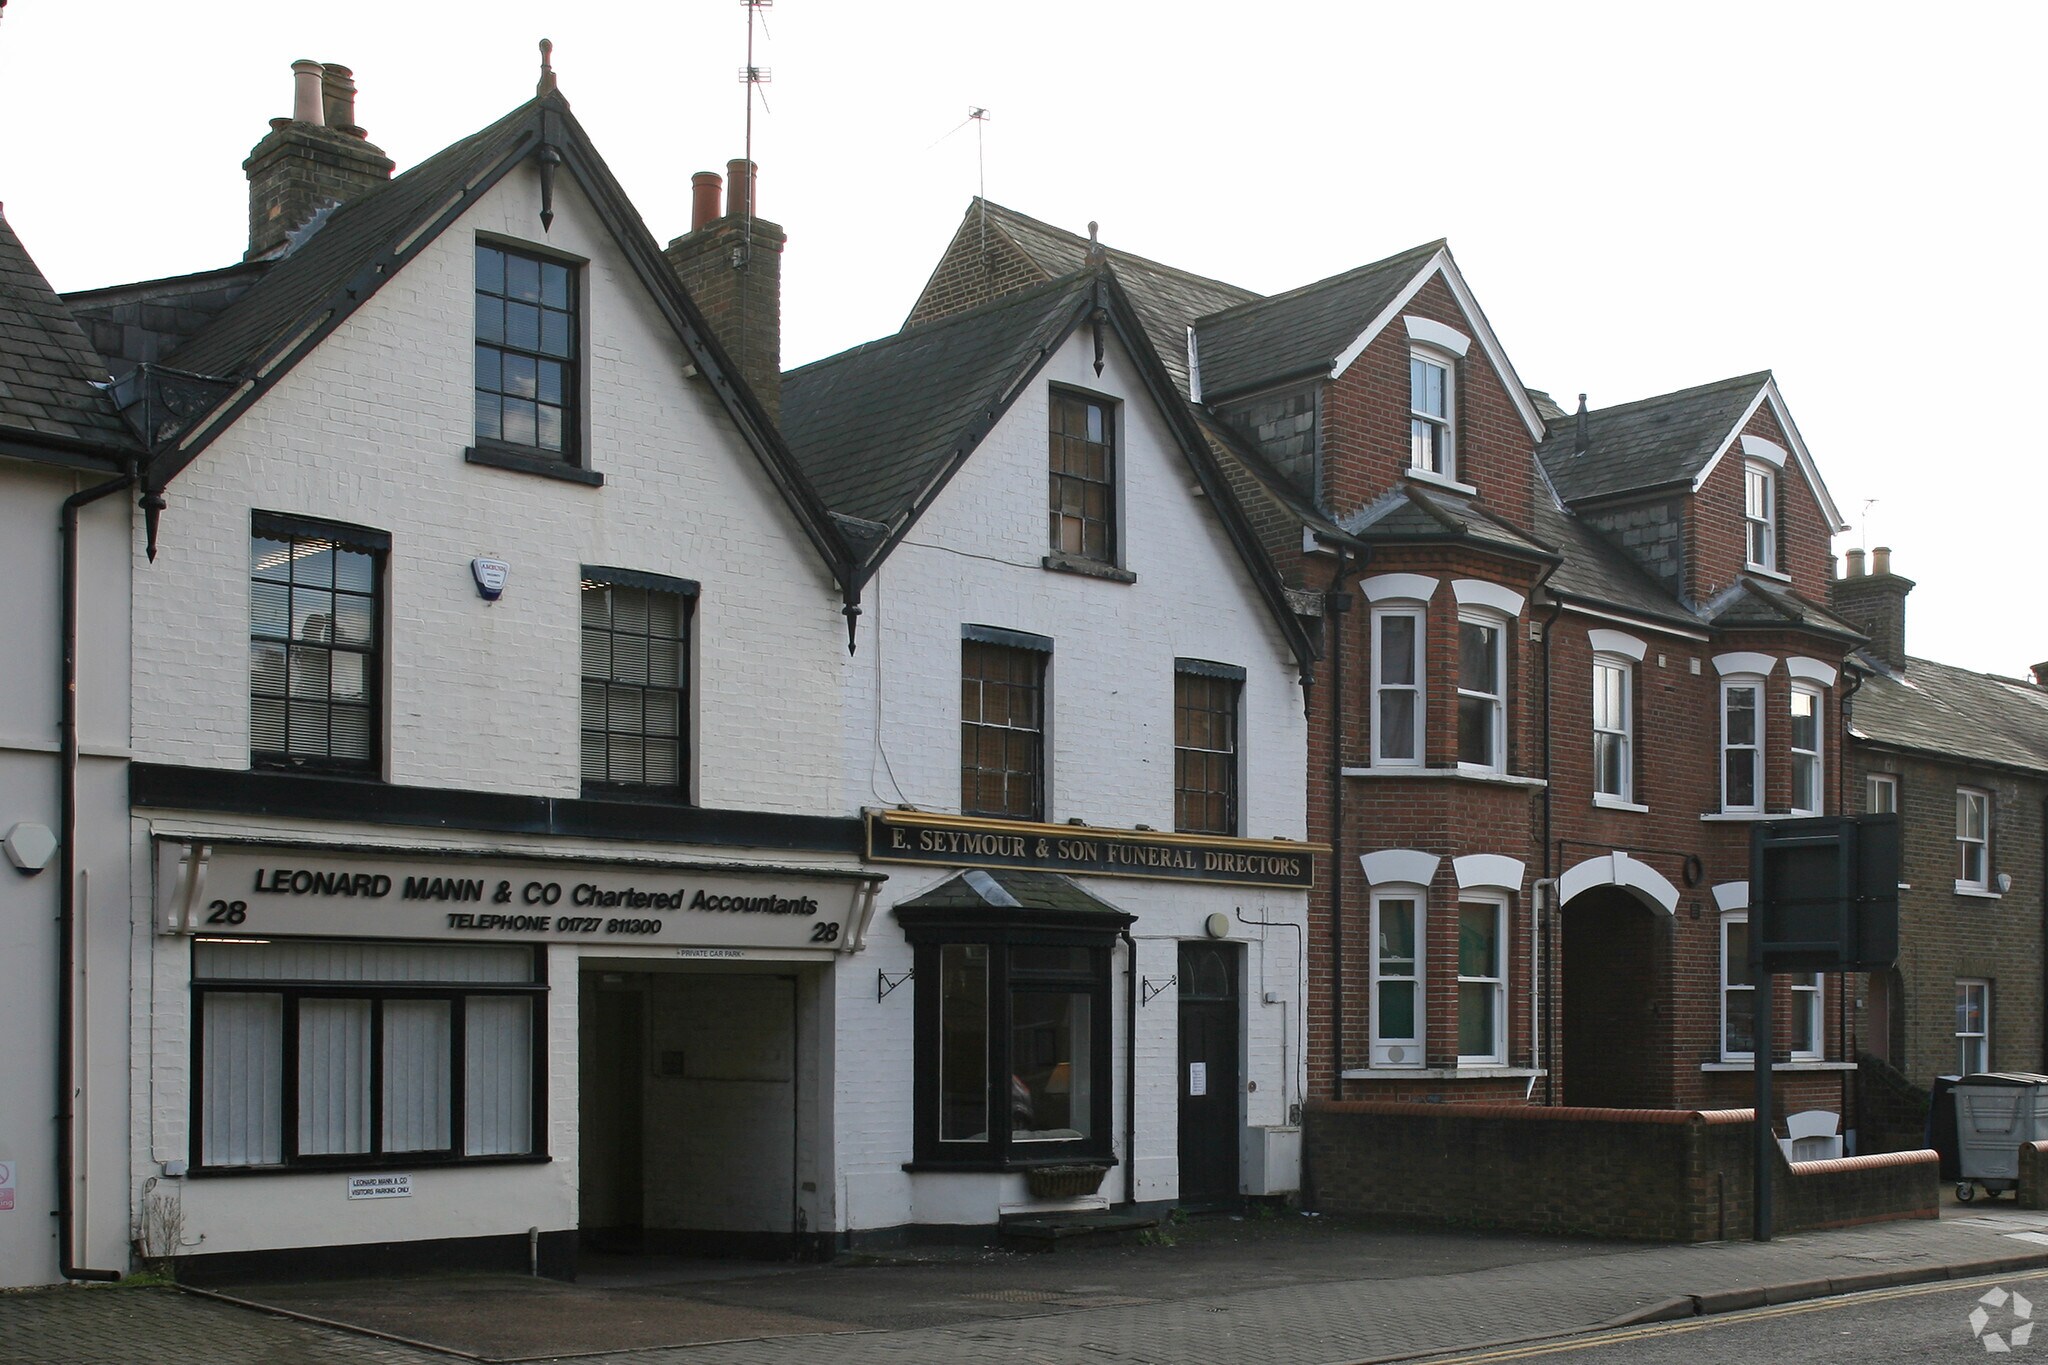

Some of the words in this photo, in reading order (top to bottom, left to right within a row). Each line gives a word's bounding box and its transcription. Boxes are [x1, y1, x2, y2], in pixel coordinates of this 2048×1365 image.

[892, 828, 911, 849] E.
[920, 830, 1026, 857] SEYMOUR
[1035, 838, 1049, 858] &
[1058, 840, 1098, 861] SON
[1107, 843, 1197, 870] FUNERAL
[1204, 852, 1300, 877] DIRECTORS
[254, 868, 392, 898] LEONARD
[403, 876, 484, 901] MANN
[492, 880, 512, 903] &
[523, 881, 561, 905] CO
[572, 883, 684, 910] Chartered
[689, 889, 818, 915] Accountants
[207, 900, 247, 924] 28
[447, 913, 551, 931] TELEPHONE
[557, 916, 602, 932] 01727
[607, 918, 662, 934] 811300
[811, 922, 840, 942] 28
[351, 1188, 374, 1196] VISITORS
[353, 1179, 377, 1187] LEONARD
